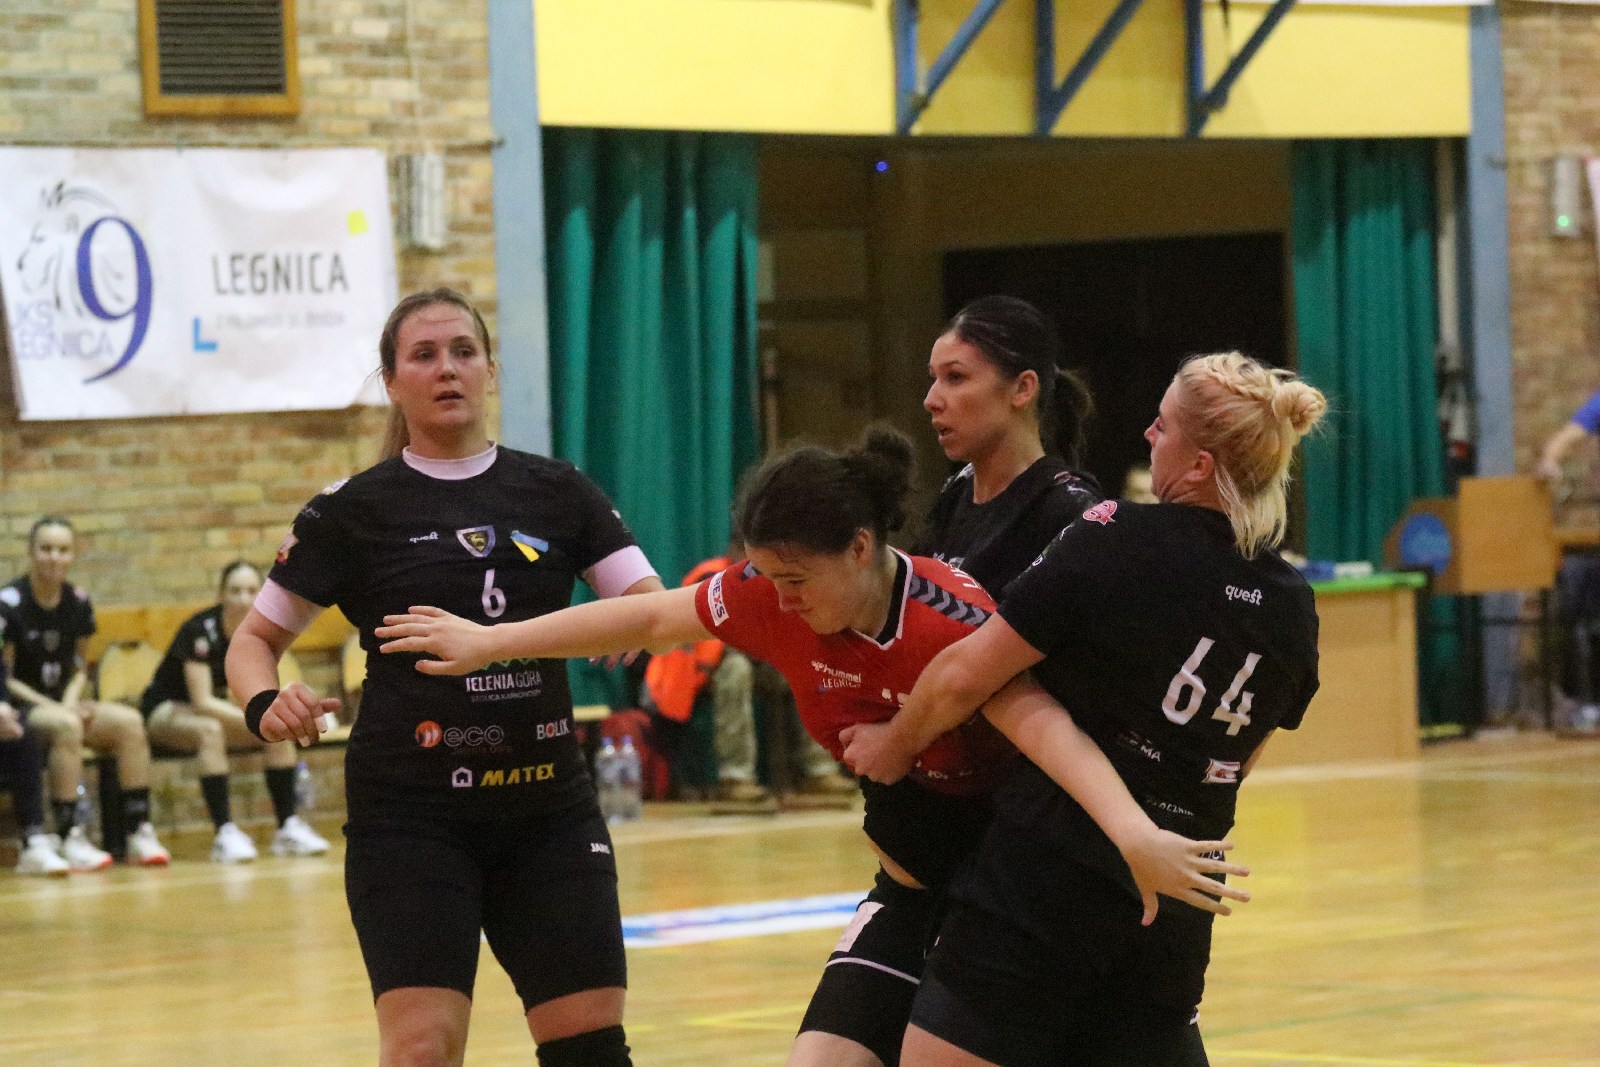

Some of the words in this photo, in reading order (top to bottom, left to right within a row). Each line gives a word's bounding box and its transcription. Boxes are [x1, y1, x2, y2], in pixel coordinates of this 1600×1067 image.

[211, 251, 349, 295] LEGNICA
[77, 216, 153, 384] 9
[482, 567, 507, 618] 6
[1225, 583, 1263, 606] quest
[823, 664, 862, 684] hummel
[1161, 636, 1263, 737] 64
[444, 725, 504, 746] eco
[537, 718, 569, 740] BOLIX
[480, 763, 555, 787] MATEX
